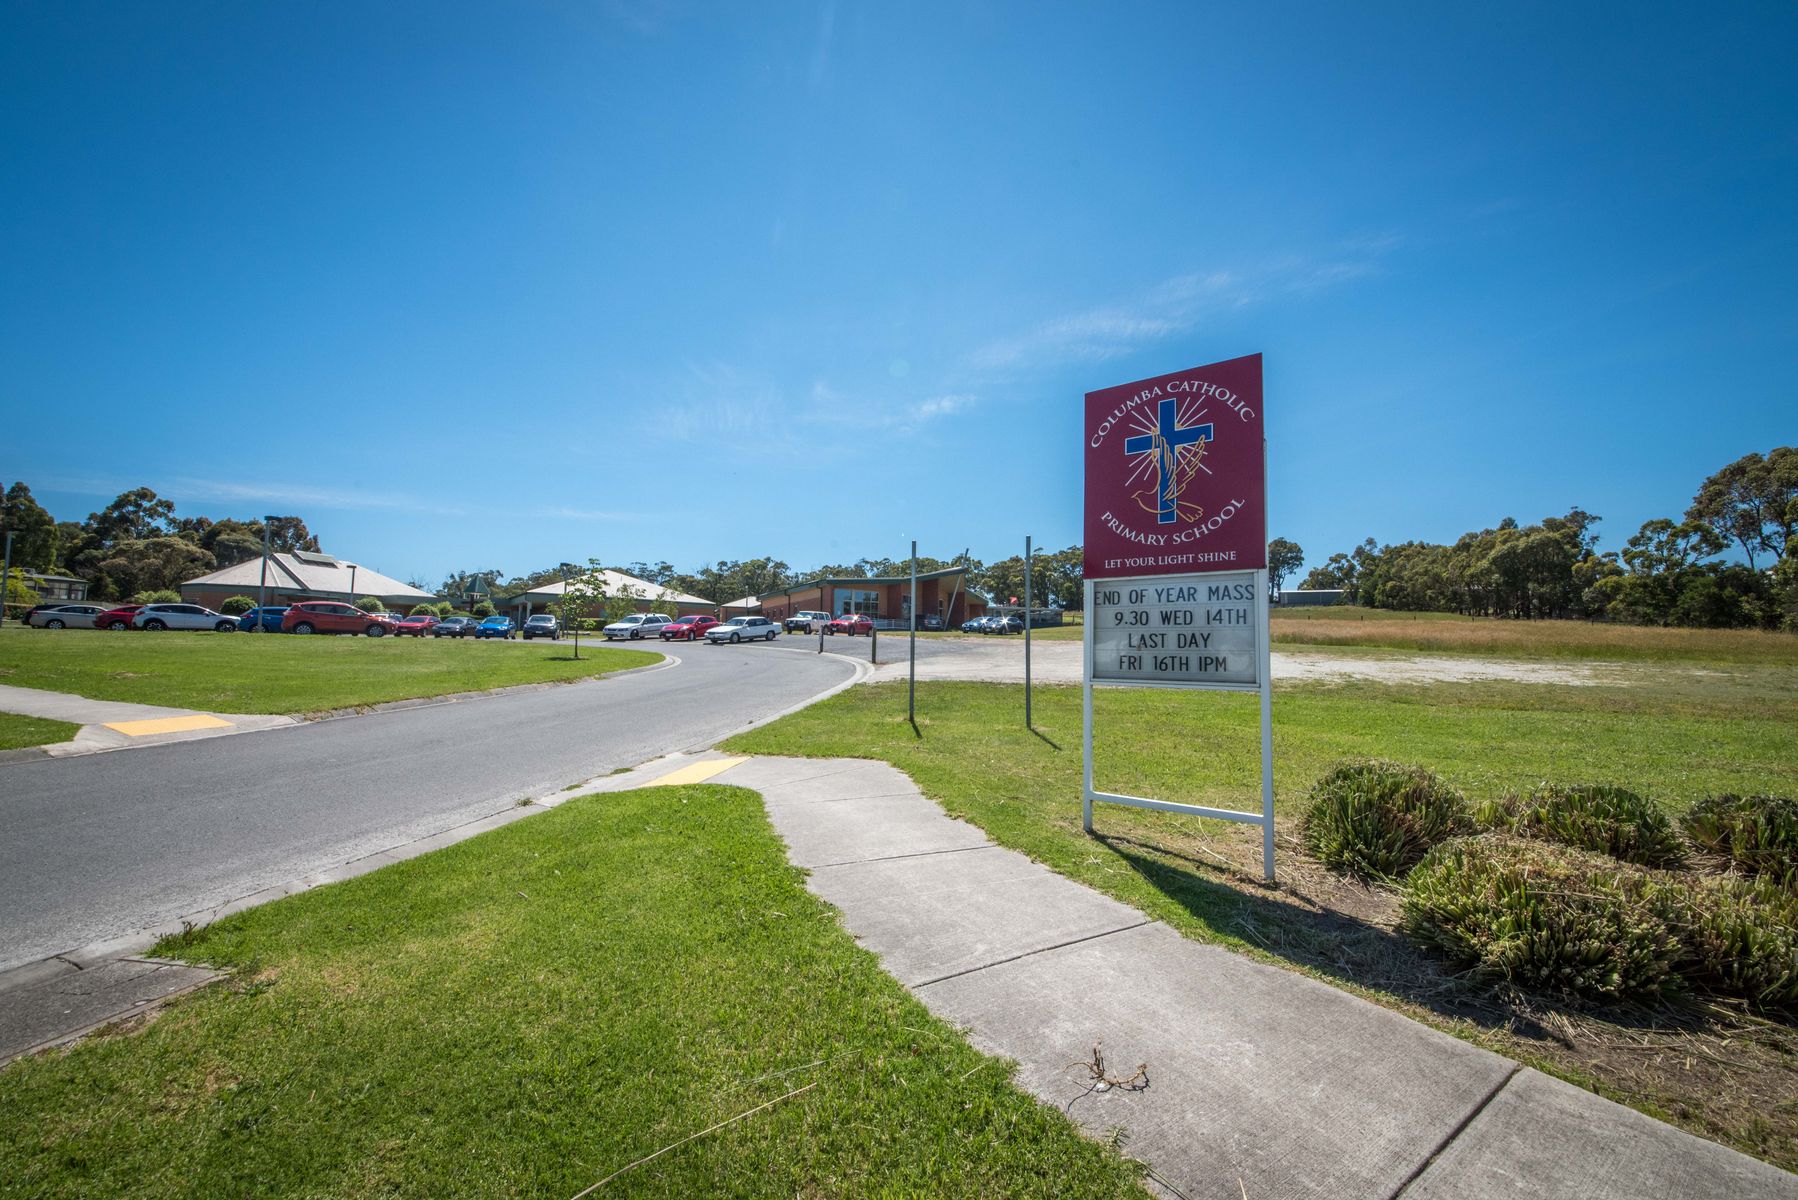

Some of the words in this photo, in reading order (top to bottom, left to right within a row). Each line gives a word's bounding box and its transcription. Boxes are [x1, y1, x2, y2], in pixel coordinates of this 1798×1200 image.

[1091, 386, 1162, 448] COLUMBA
[1167, 381, 1255, 422] CATHOLIC
[1101, 512, 1168, 545] PRIMARY
[1173, 499, 1245, 545] SCHOOL
[1105, 560, 1122, 569] LET
[1124, 557, 1156, 567] YOUR
[1158, 554, 1195, 565] LIGHT
[1198, 551, 1236, 562] SHINE
[1095, 591, 1120, 605] END
[1129, 589, 1147, 604] OF
[1155, 587, 1197, 603] YEAR
[1208, 584, 1255, 601] MASS
[1115, 611, 1149, 626] 9.30
[1160, 610, 1193, 625] WED
[1206, 609, 1247, 625] 14TH
[1128, 633, 1167, 648] LAST
[1178, 633, 1211, 648] DAY
[1119, 655, 1142, 670] FRI
[1154, 656, 1188, 671] 16TH
